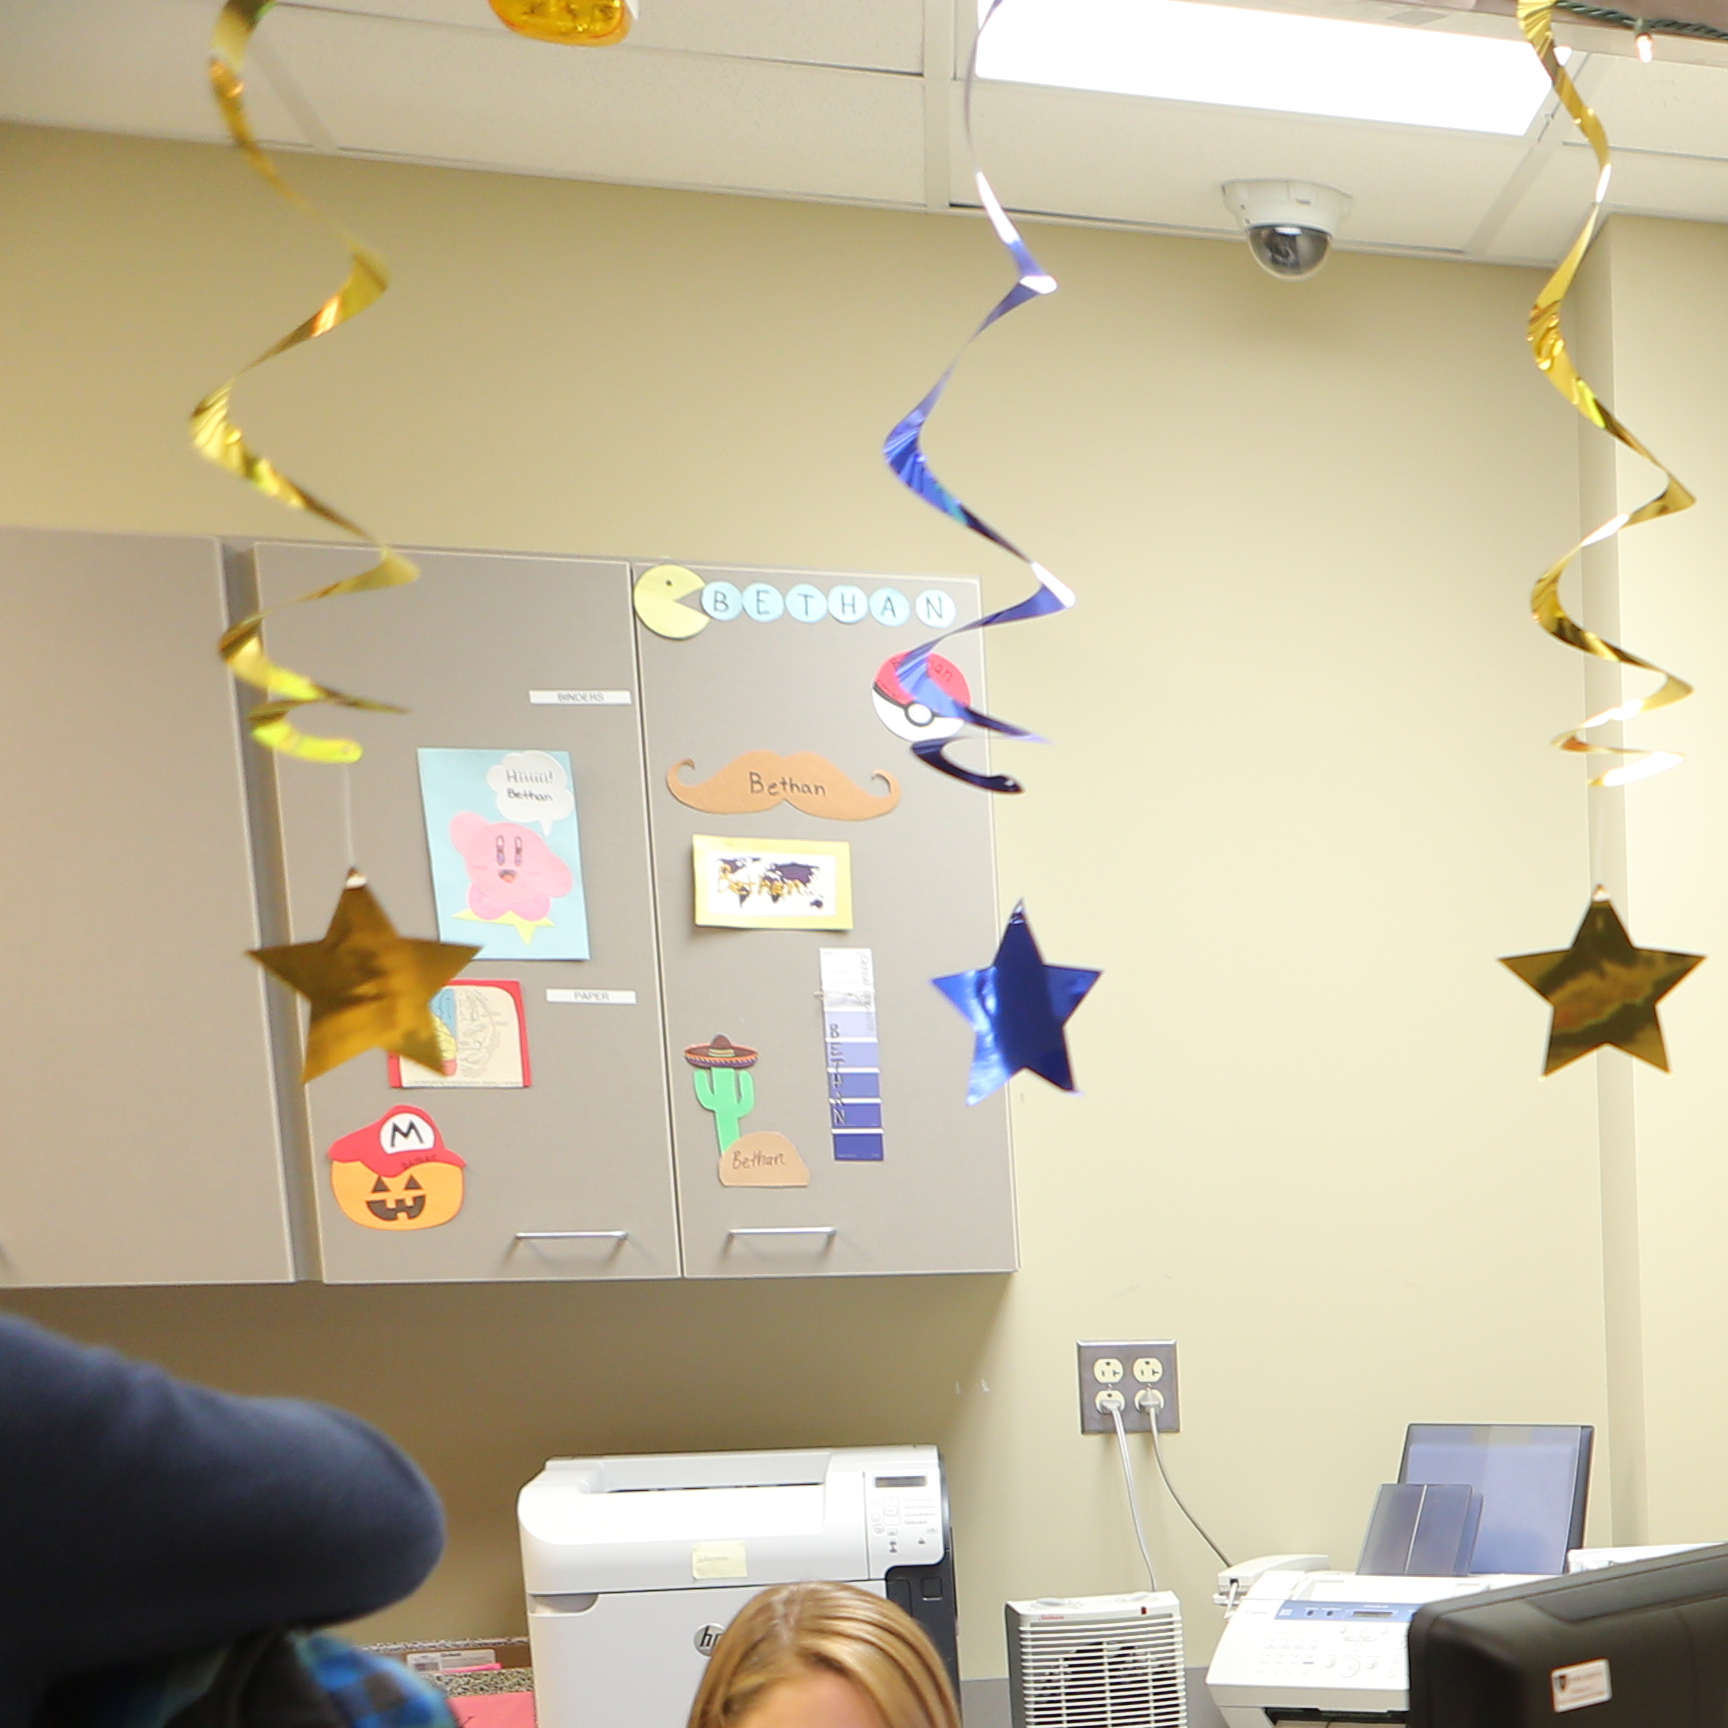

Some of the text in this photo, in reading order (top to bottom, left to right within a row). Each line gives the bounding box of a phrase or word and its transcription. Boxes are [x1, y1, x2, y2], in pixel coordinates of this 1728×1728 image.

[712, 589, 945, 620] BETHAN
[556, 692, 605, 703] BINDERS
[748, 770, 827, 797] Bethan
[506, 787, 554, 802] Bethan
[573, 990, 610, 1001] PAPER
[389, 1119, 424, 1148] M
[732, 1150, 787, 1169] Bethan
